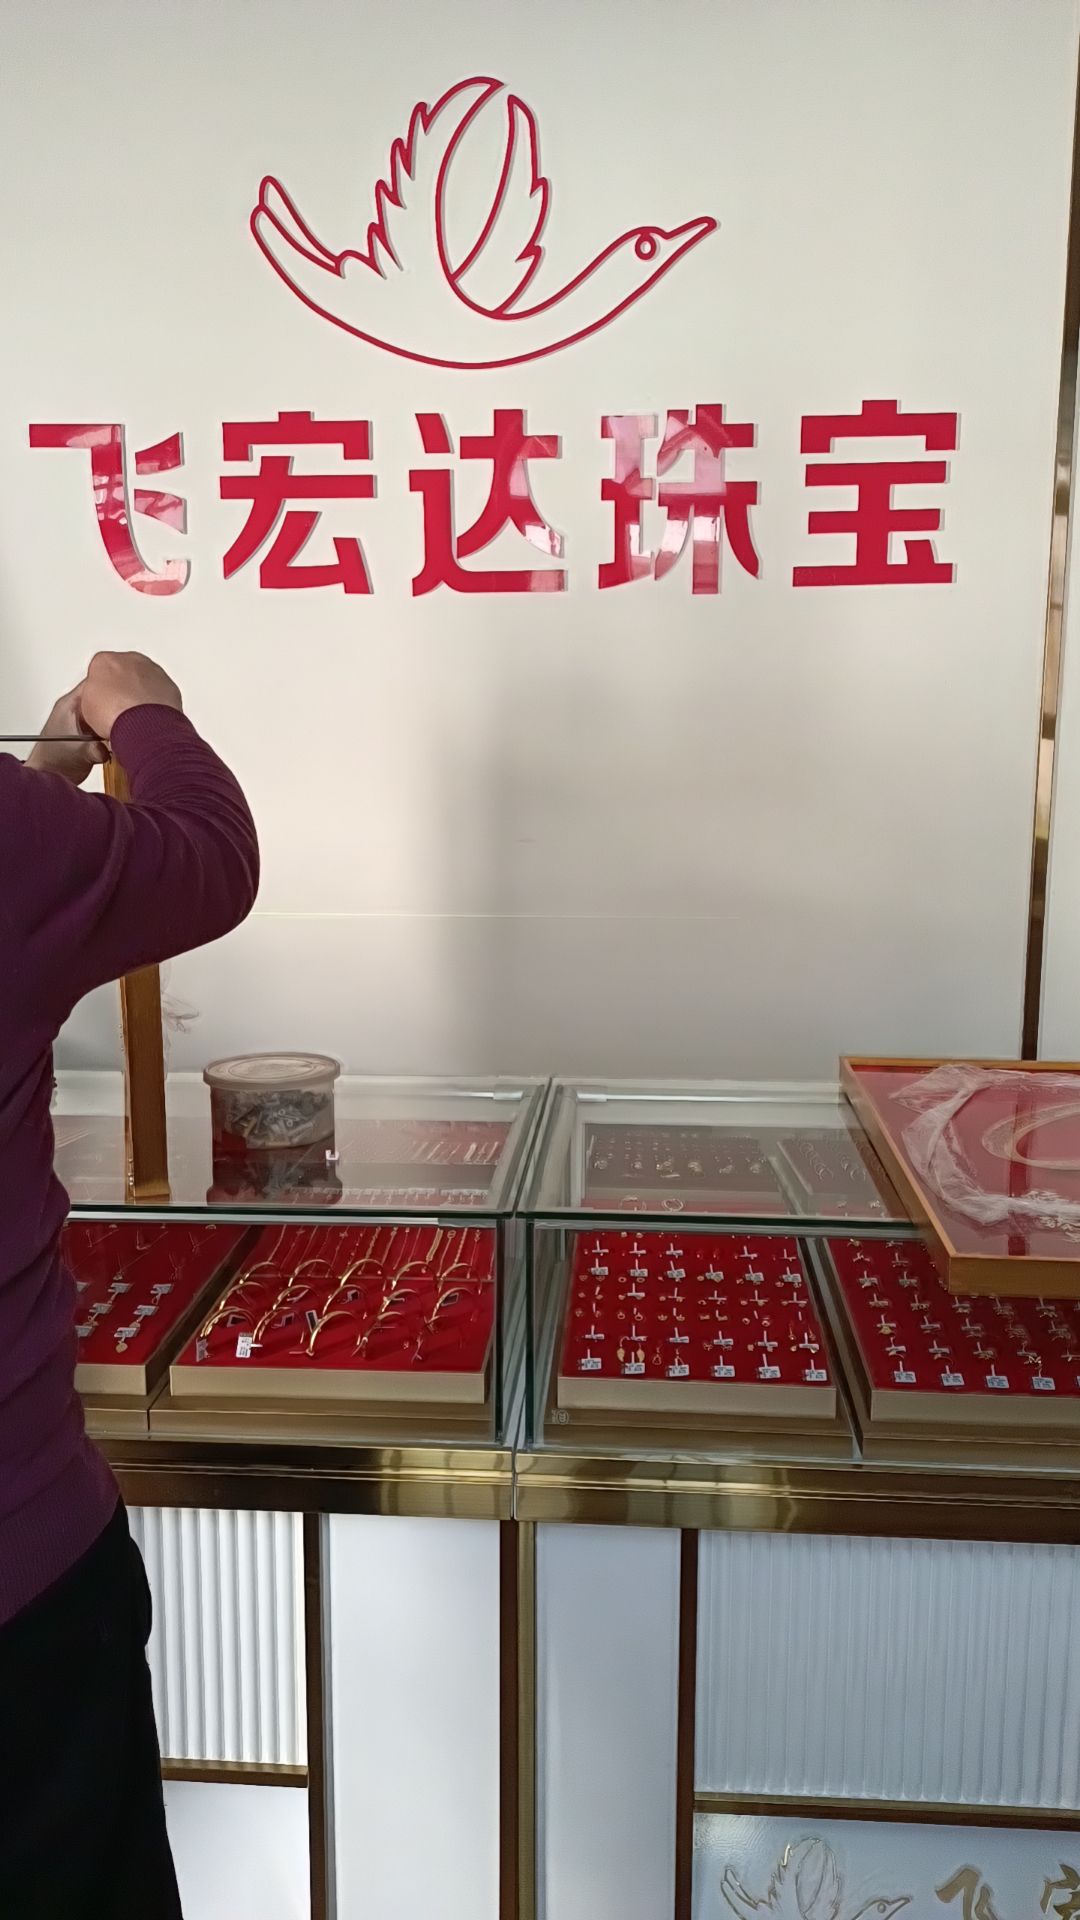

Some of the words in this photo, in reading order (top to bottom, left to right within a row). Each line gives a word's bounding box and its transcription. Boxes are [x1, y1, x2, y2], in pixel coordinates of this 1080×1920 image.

[29, 400, 959, 597] 飞宏达珠宝
